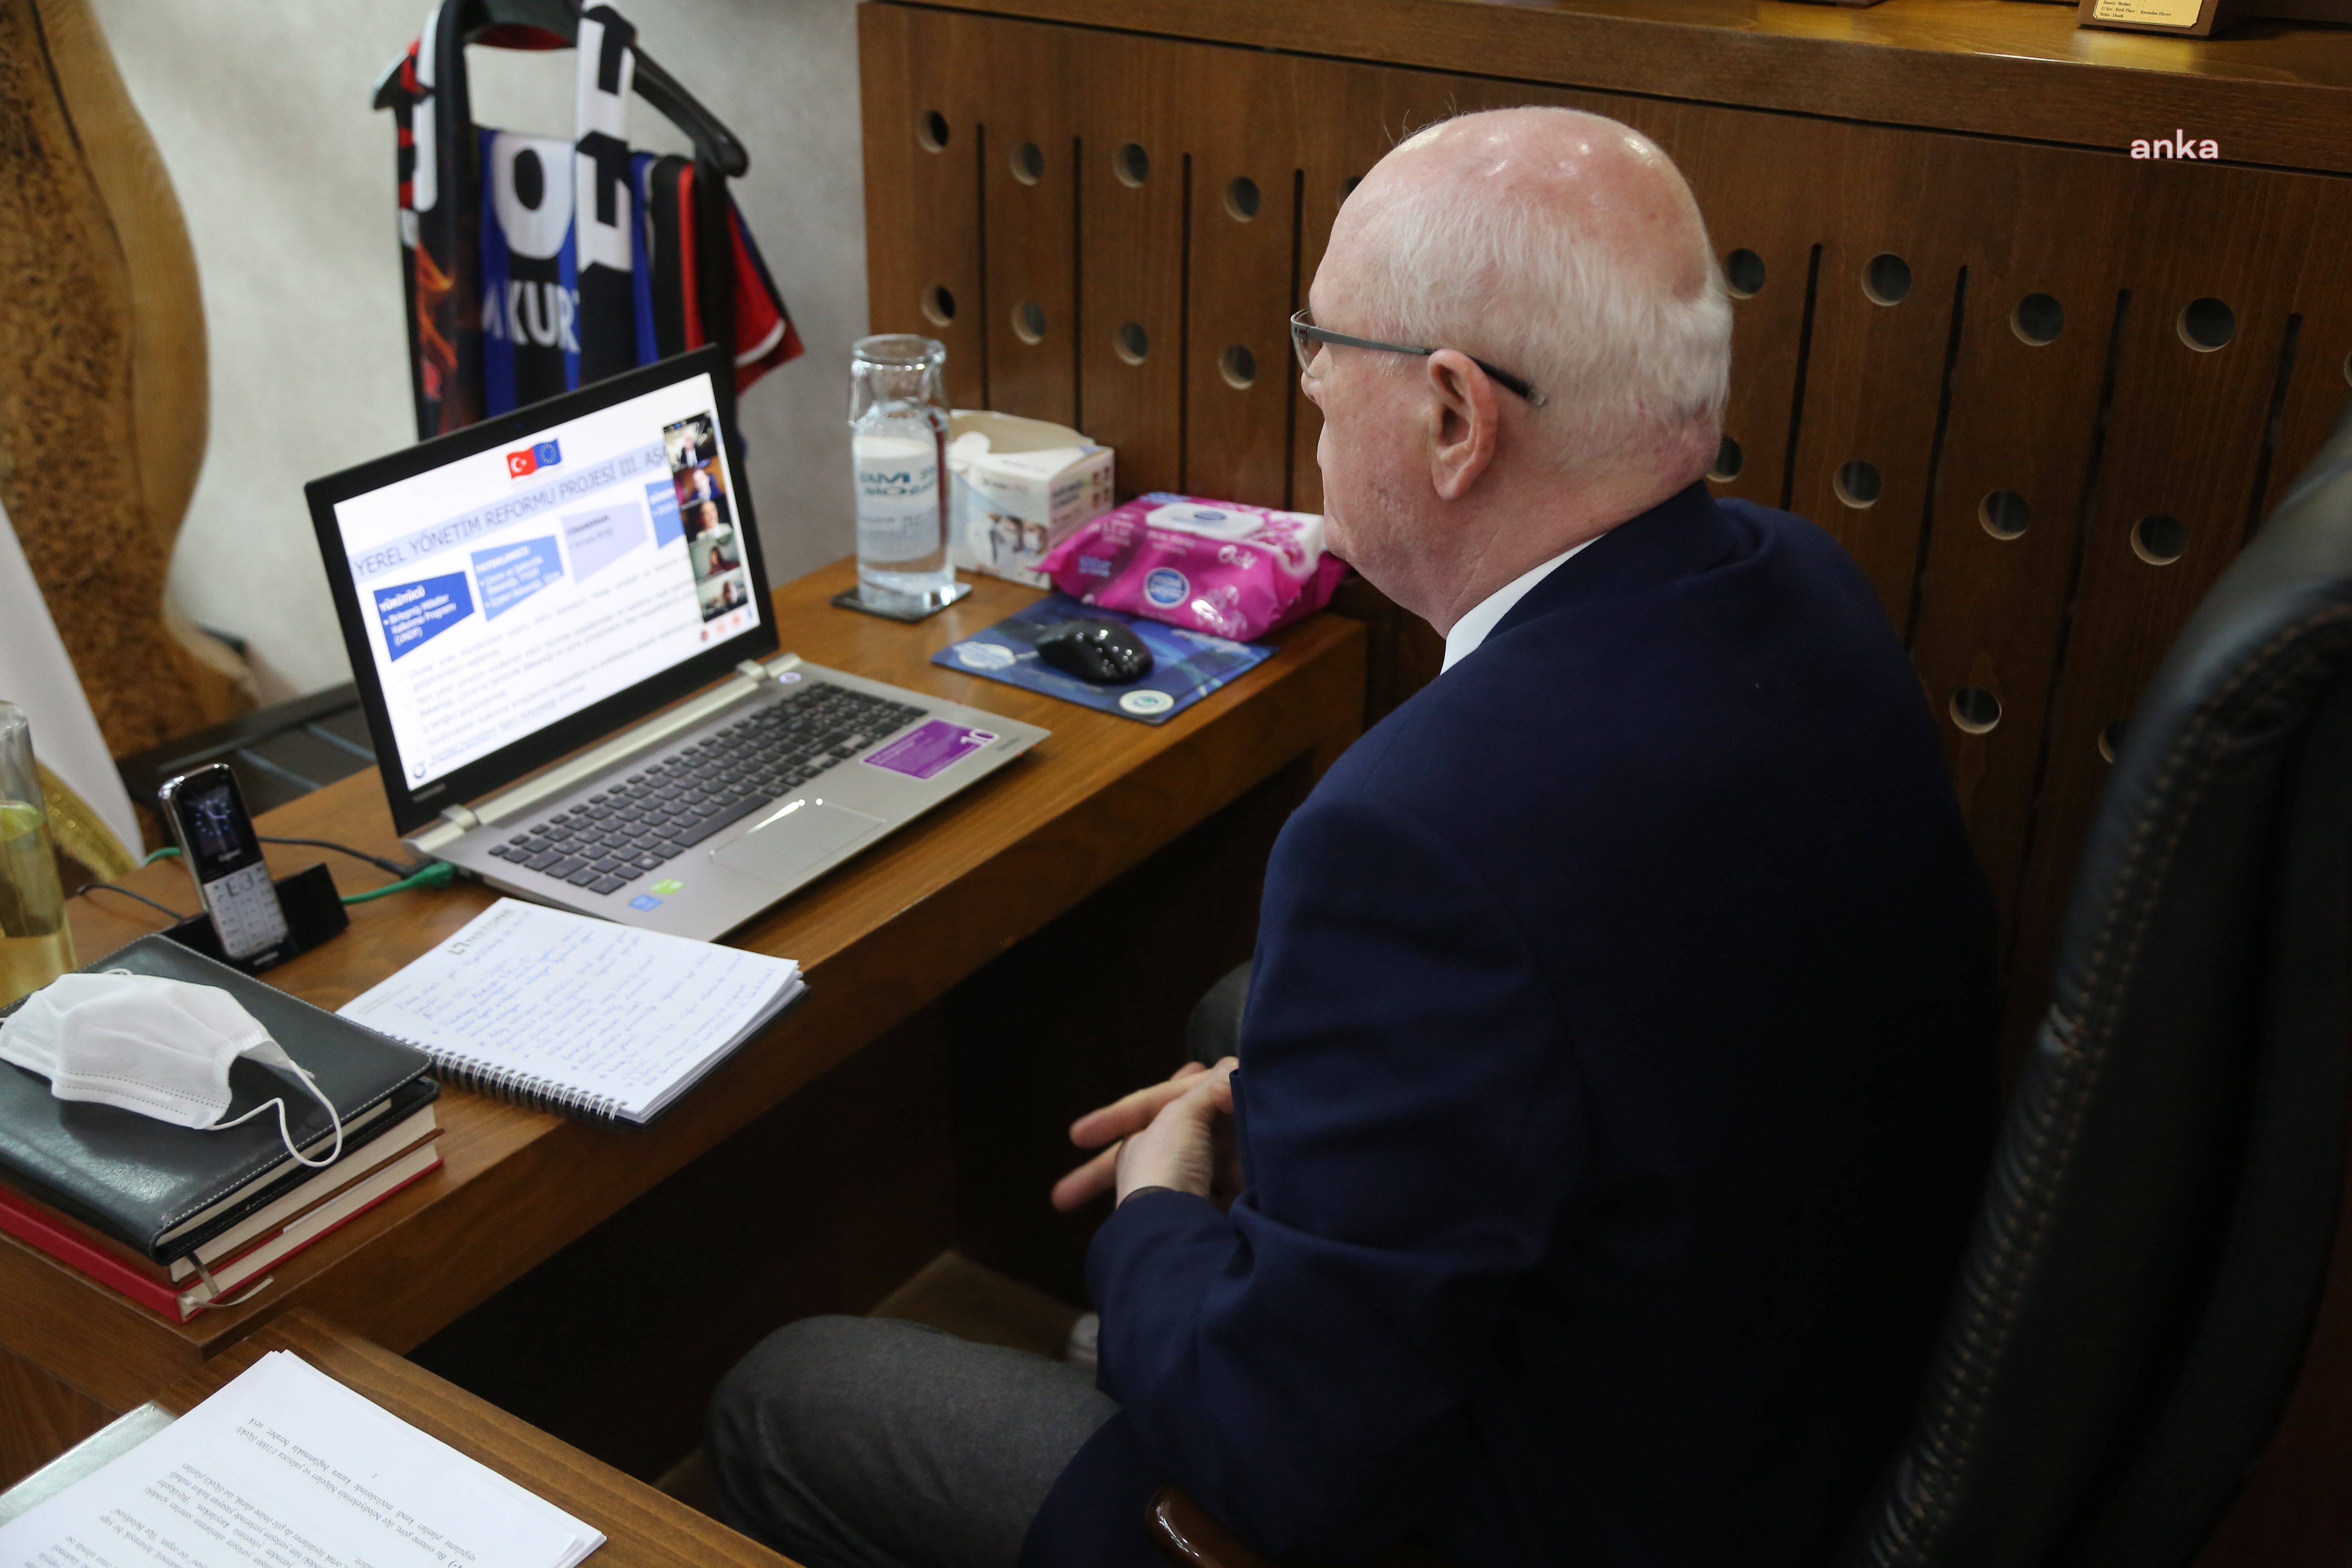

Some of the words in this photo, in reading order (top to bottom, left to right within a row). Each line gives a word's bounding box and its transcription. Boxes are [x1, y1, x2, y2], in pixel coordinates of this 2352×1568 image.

[354, 547, 405, 575] YEREL
[409, 517, 481, 554] YÖNETİM
[485, 489, 555, 526] REFORMU
[559, 464, 615, 497] PROJESİ
[248, 1417, 264, 1428] sevk
[234, 1425, 258, 1442] ölçekli
[266, 1428, 290, 1447] beraber,
[255, 1439, 278, 1454] 1/1000
[277, 1452, 305, 1470] yalnızca
[292, 1444, 330, 1472] bağlanmakla
[181, 1463, 207, 1479] planları
[331, 1469, 352, 1486] karara
[201, 1476, 225, 1492] ölçekli
[309, 1473, 338, 1493] bütçeleri
[144, 1486, 169, 1505] içindeki
[191, 1484, 211, 1500] halkın
[223, 1489, 234, 1499] üst
[353, 1483, 394, 1510] meclislerinde
[169, 1502, 193, 1519] sınırları
[209, 1496, 237, 1515] yaşayan
[234, 1495, 255, 1510] alarak,
[337, 1489, 382, 1521] belediyelerinin
[99, 1515, 112, 1526] yapı
[196, 1503, 230, 1528] karşılarken,
[233, 1512, 266, 1533] yerlerinde
[253, 1509, 273, 1523] önüne
[381, 1517, 395, 1528] ilçe
[394, 1510, 415, 1525] kendi
[112, 1524, 124, 1534] bir
[193, 1518, 226, 1540] alanlarının
[271, 1521, 287, 1530] göz
[283, 1528, 293, 1536] da
[396, 1525, 414, 1537] göre,
[416, 1523, 444, 1541] planları
[122, 1530, 154, 1554] hiyerarşik
[232, 1528, 265, 1549] yönetimle
[263, 1530, 292, 1550] yerleşim
[292, 1533, 325, 1557] faydalarını
[411, 1536, 436, 1552] sisteme
[177, 1550, 189, 1559] üst
[225, 1539, 255, 1558] yerleşim
[289, 1548, 303, 1558] tüm
[435, 1550, 447, 1561] Bu
[444, 1540, 476, 1561] uygulama
[324, 1554, 342, 1567] ortak
